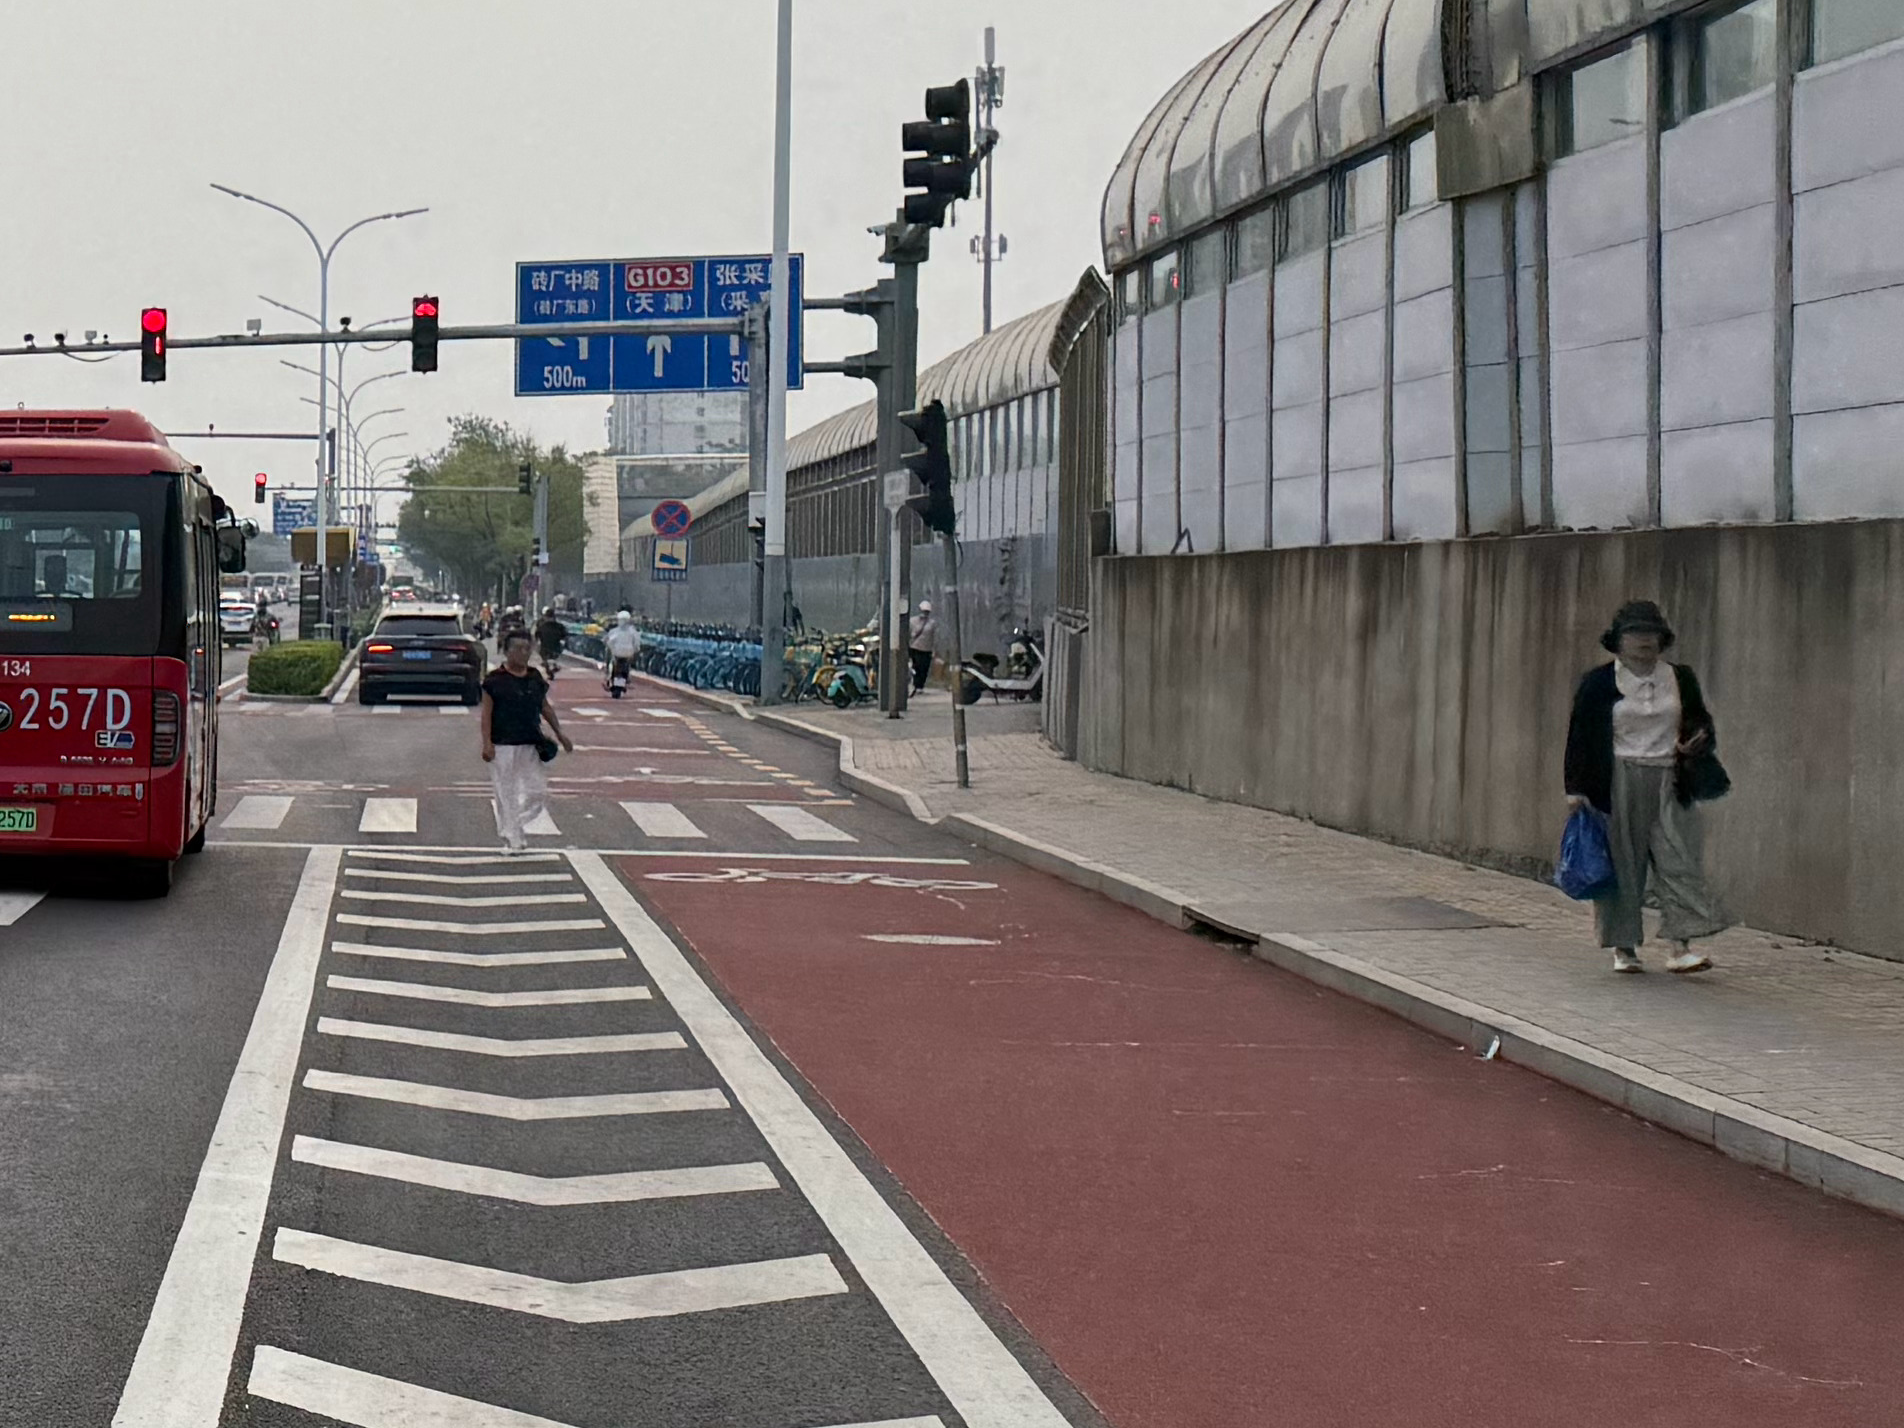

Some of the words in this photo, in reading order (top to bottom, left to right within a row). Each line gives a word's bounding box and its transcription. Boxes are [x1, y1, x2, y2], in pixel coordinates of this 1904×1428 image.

[531, 269, 599, 292] 砖厂中路
[628, 267, 689, 287] G103
[715, 263, 772, 286] 张采
[543, 365, 586, 389] 500m
[19, 687, 132, 731] 257D
